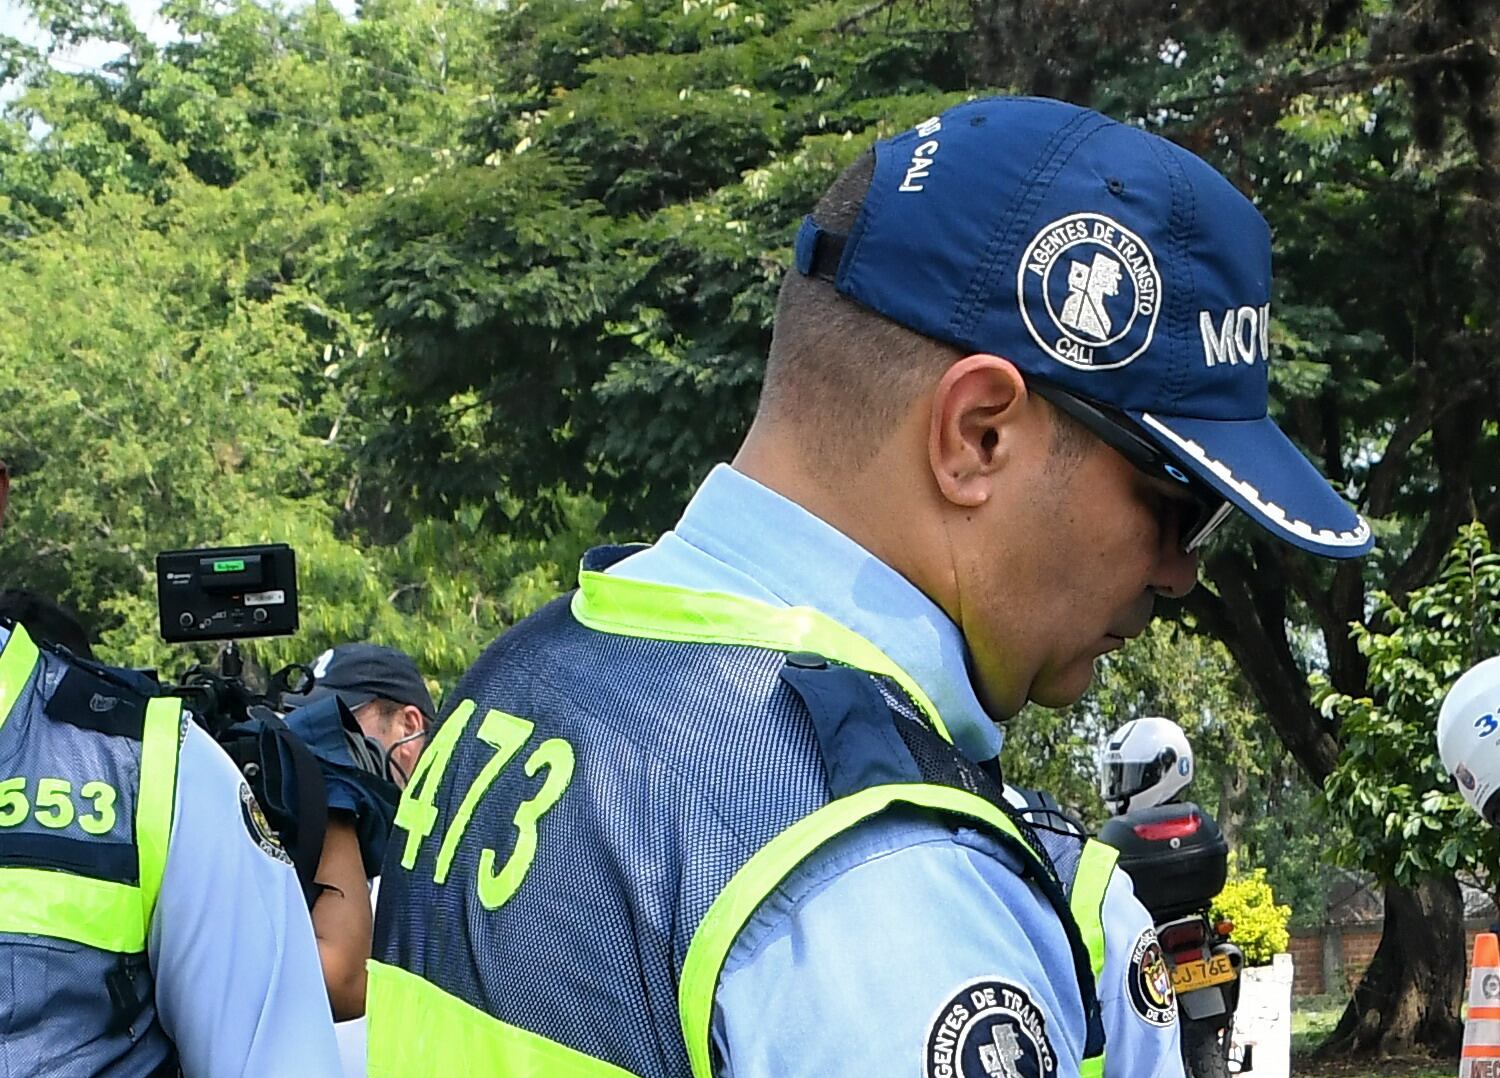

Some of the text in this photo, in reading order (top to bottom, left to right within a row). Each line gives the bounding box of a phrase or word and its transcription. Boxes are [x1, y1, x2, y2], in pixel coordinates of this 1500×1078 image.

[899, 141, 939, 191] CALI
[1028, 221, 1156, 315] AGENTES DE TRANSITO
[1056, 337, 1093, 364] CALI
[0, 777, 116, 834] 553
[394, 699, 575, 910] 473
[971, 988, 996, 1010] DE
[1002, 989, 1052, 1072] TRANSITO
